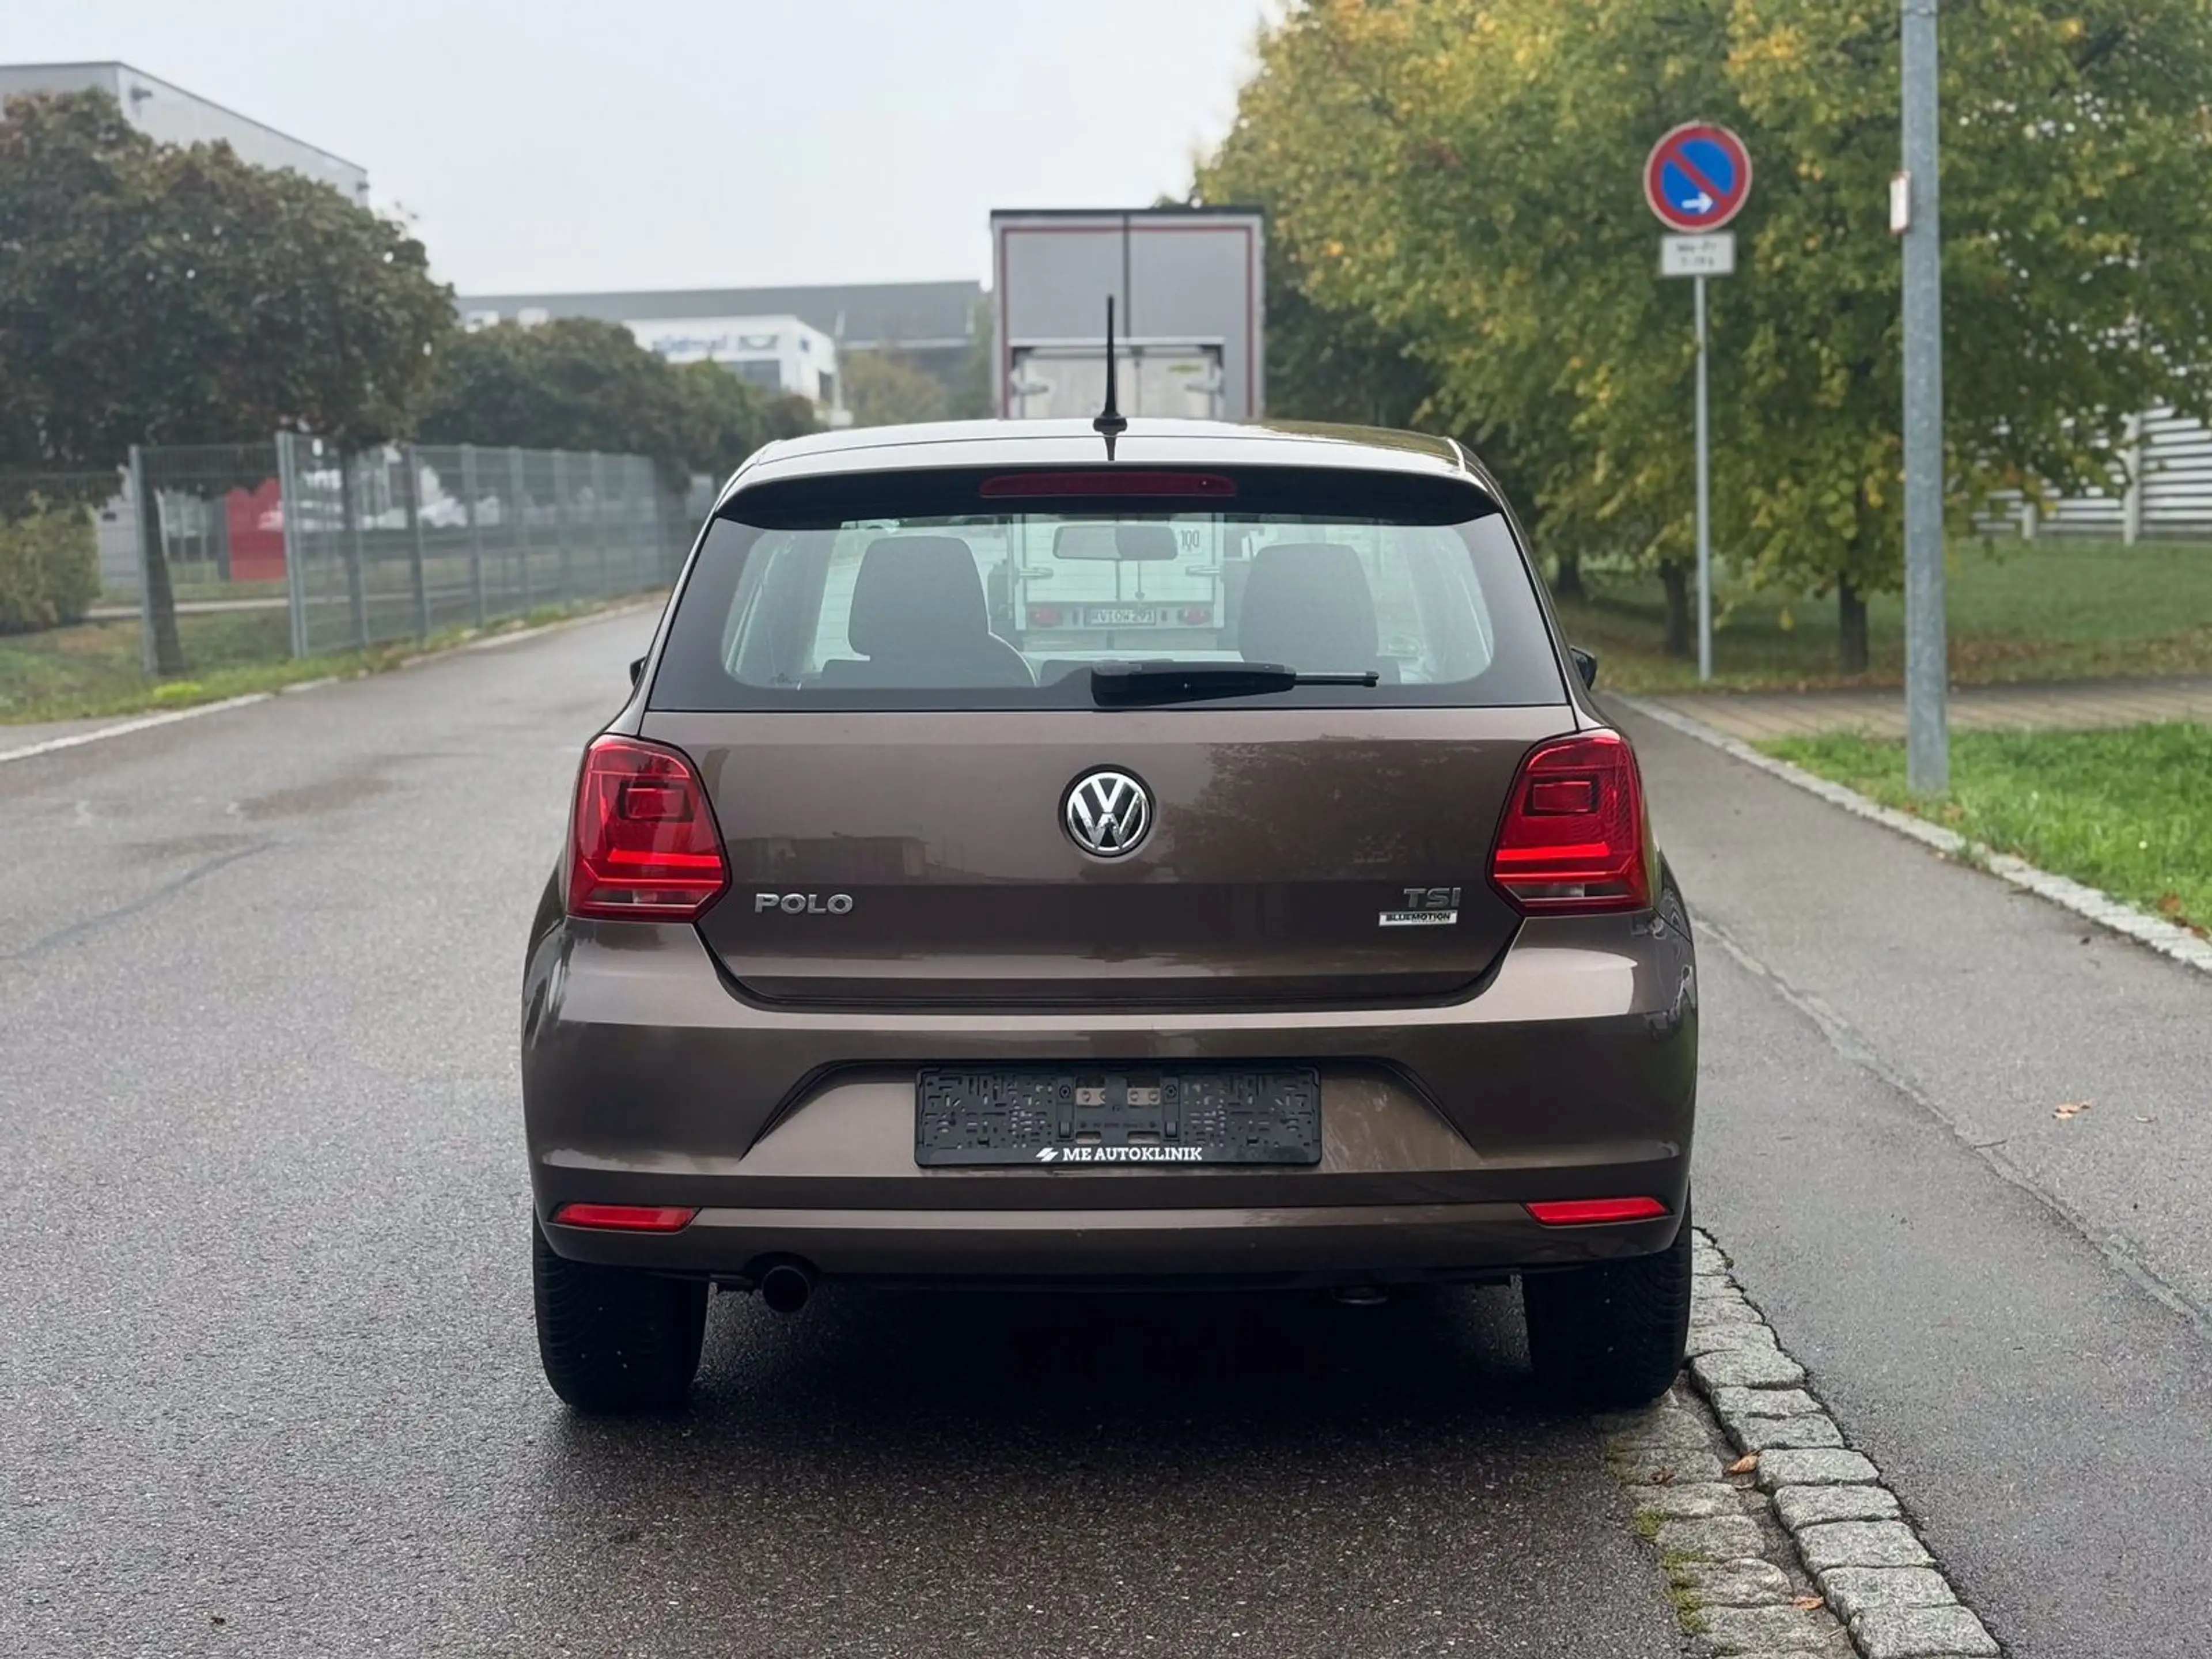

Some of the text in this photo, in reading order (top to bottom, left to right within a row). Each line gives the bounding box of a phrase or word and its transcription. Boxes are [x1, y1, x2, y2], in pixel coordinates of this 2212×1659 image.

[1067, 772, 1150, 856] VW
[755, 893, 853, 915] POLO
[1404, 888, 1461, 908] TSI
[1063, 1147, 1203, 1161] ME AUTOKLINIK
